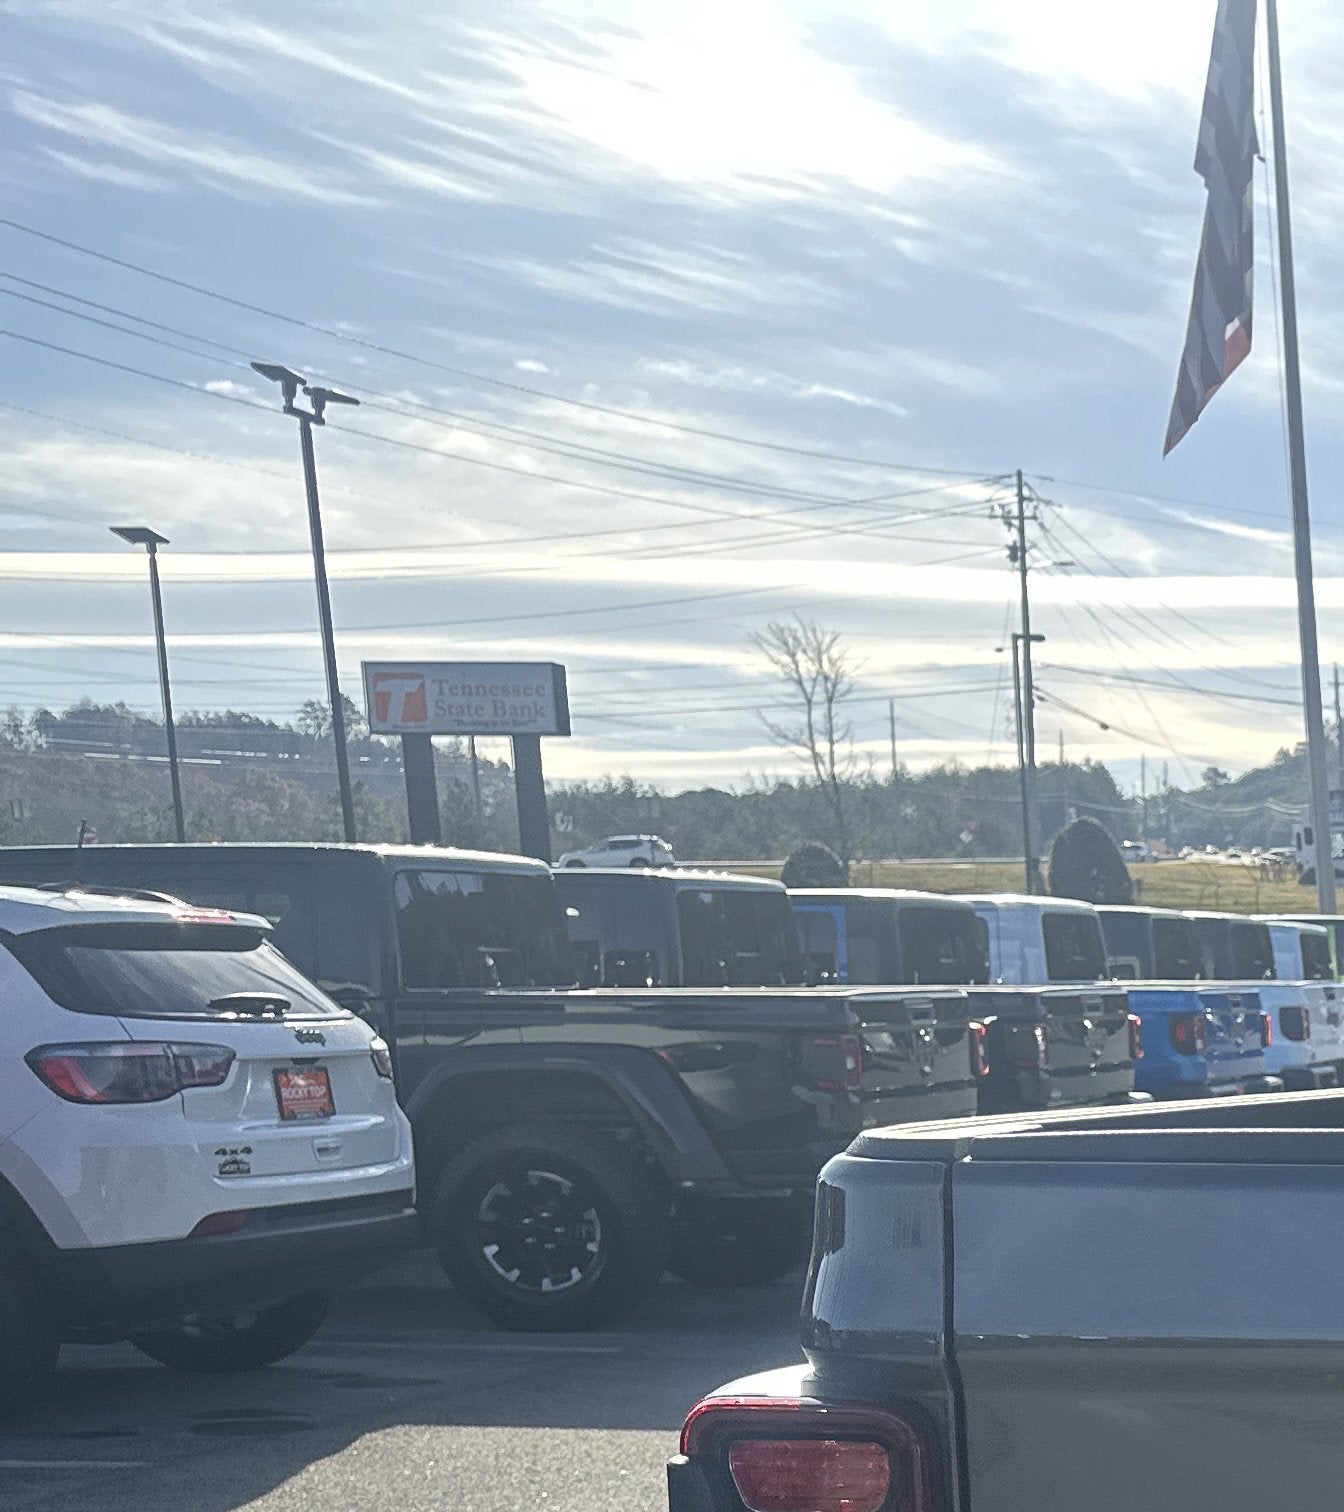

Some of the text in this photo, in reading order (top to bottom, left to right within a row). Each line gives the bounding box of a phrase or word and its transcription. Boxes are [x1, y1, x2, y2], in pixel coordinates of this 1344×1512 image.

[432, 679, 546, 698] Tennessee
[434, 700, 546, 718] State Bank
[309, 1085, 326, 1098] TOP
